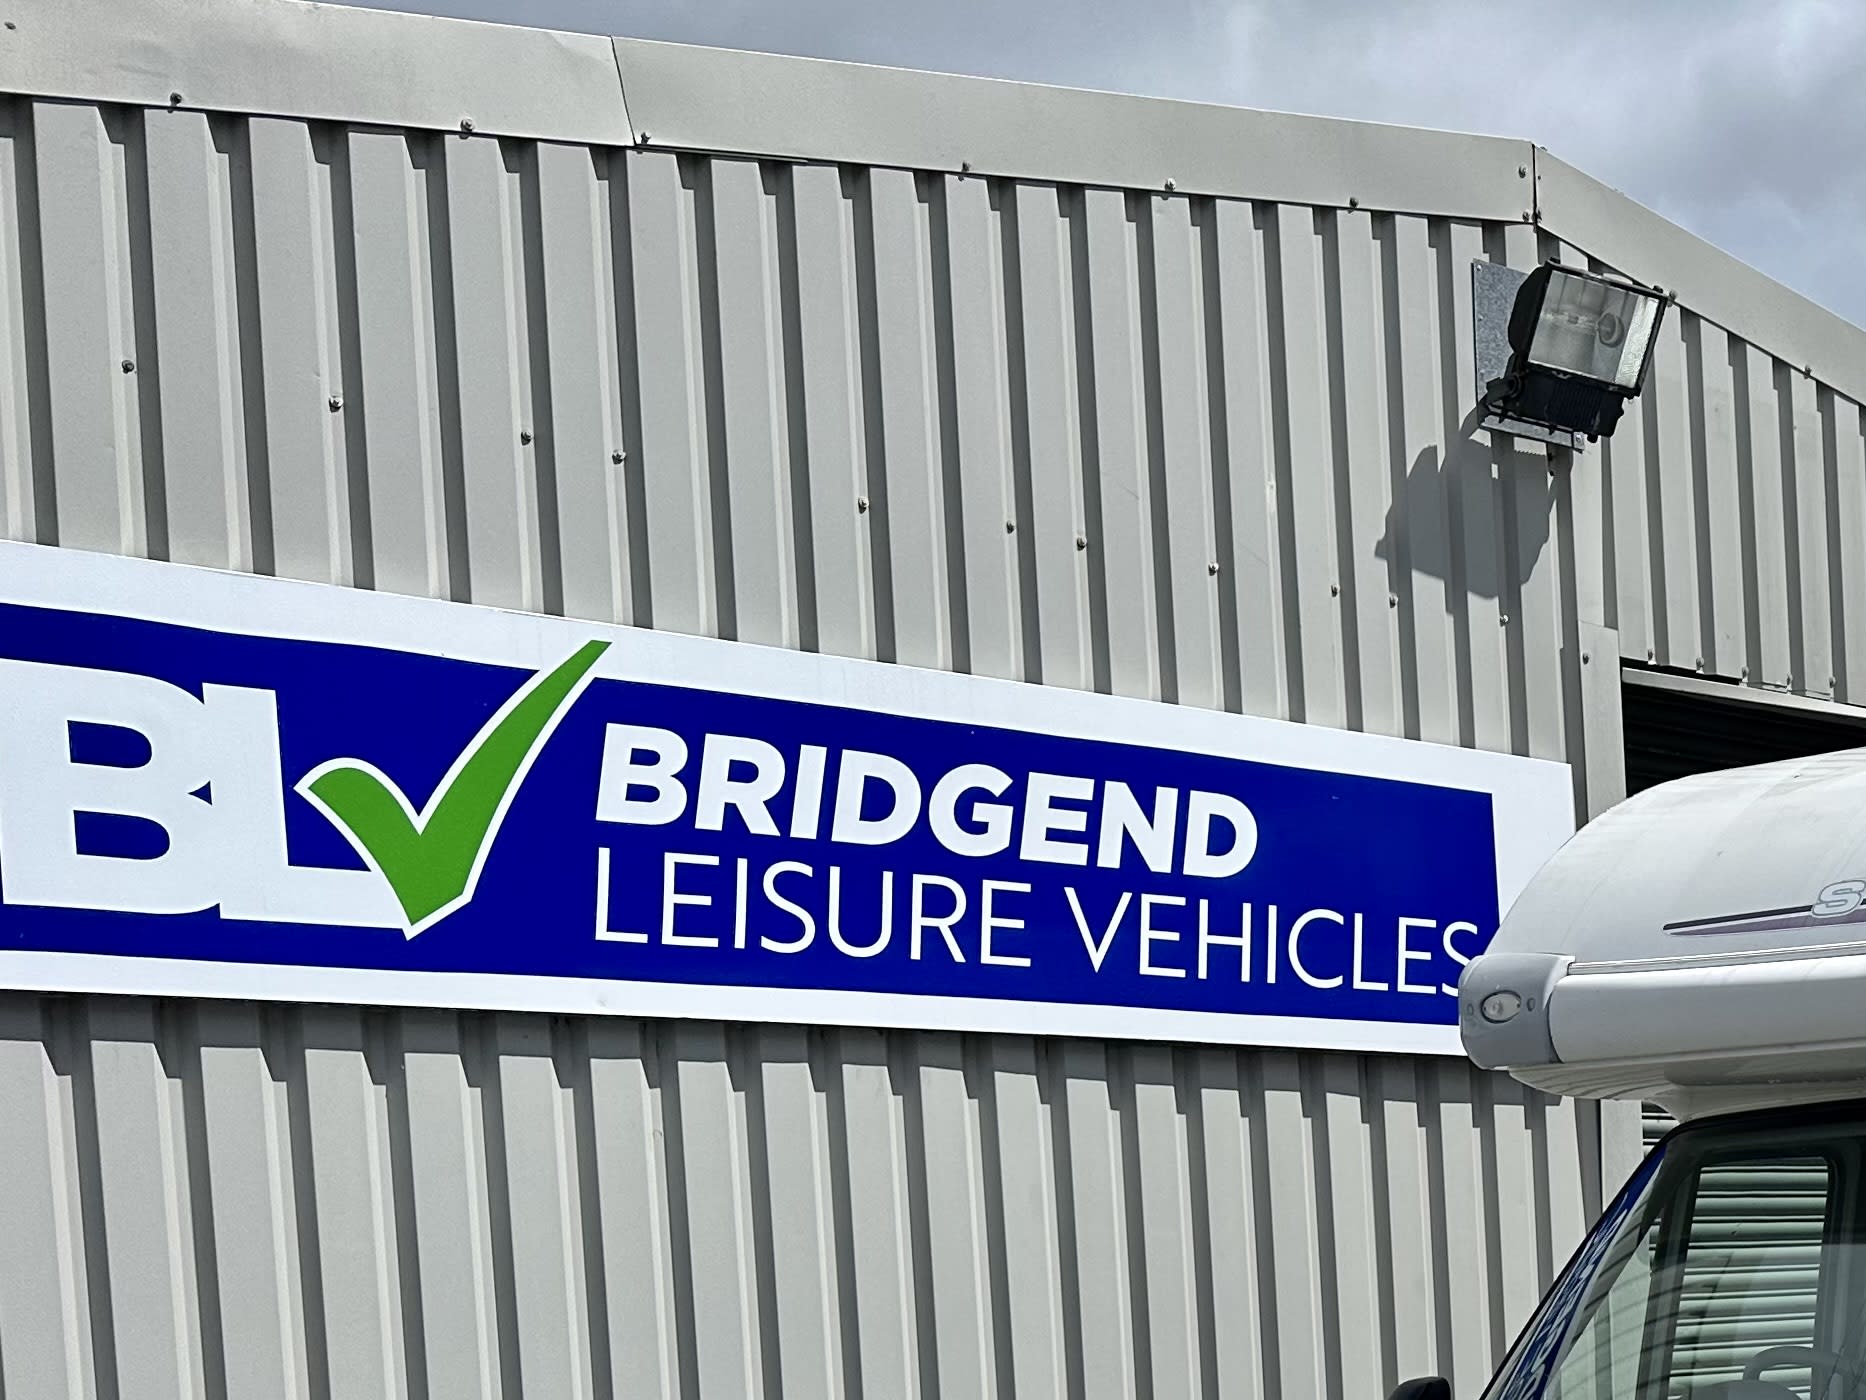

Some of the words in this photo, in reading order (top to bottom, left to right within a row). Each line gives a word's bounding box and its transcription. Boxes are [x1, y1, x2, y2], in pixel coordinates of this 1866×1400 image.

[595, 722, 1258, 879] BRIDGEND
[595, 846, 1032, 969] LEISURE
[1064, 885, 1480, 998] VEHICLES
